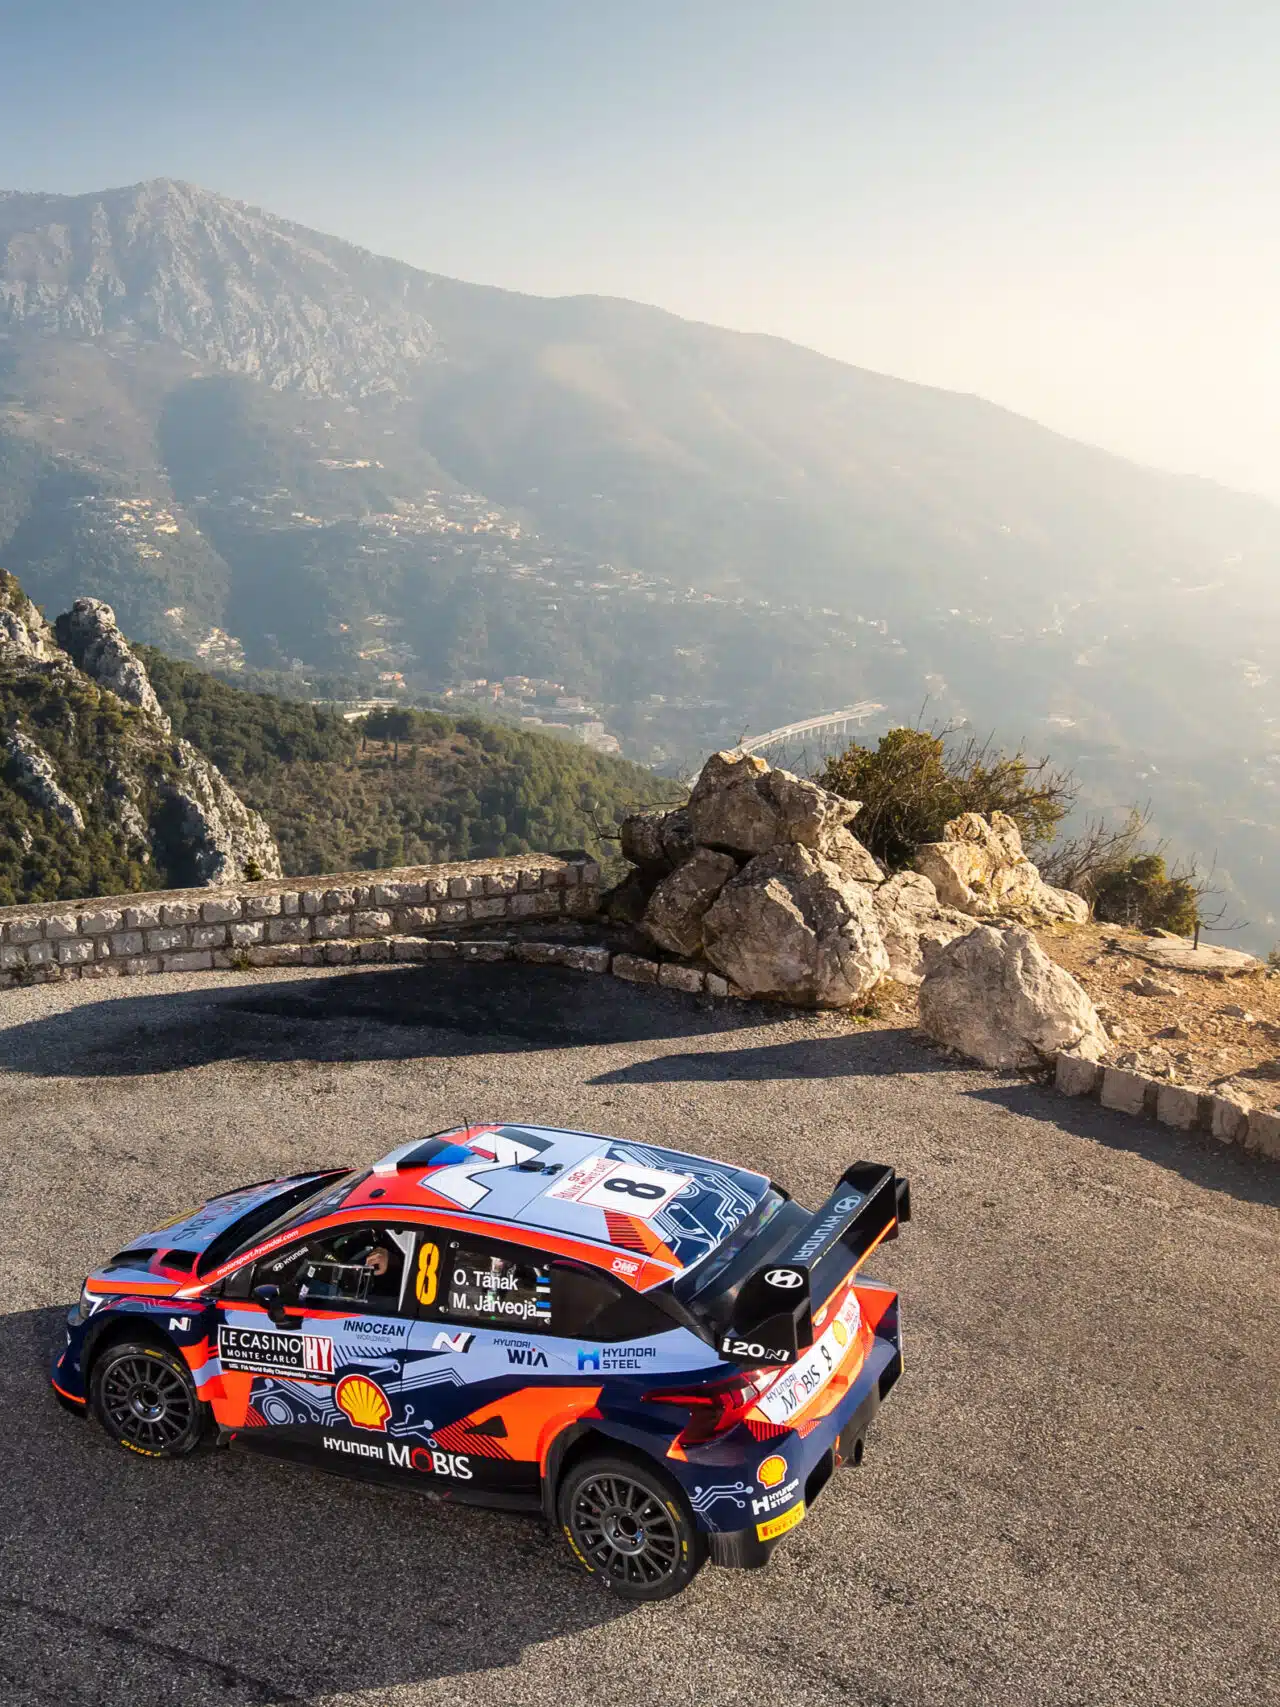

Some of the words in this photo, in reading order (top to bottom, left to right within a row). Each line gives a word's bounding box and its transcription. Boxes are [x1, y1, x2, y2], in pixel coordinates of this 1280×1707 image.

[604, 1178, 666, 1200] 8
[792, 1215, 844, 1261] HYUNDAI
[217, 1230, 299, 1276] motorsport.hyundai.com
[284, 1246, 309, 1265] HYUNDAI
[416, 1242, 440, 1305] 8
[611, 1260, 639, 1274] OMP
[454, 1269, 470, 1286] O.
[473, 1271, 518, 1290] Tänak
[453, 1293, 470, 1310] M.
[474, 1295, 537, 1320] Järveoja
[343, 1320, 406, 1337] INNOCEAN
[356, 1333, 392, 1344] WORLDWIDE
[222, 1331, 237, 1346] LE
[240, 1333, 301, 1353] CASINO
[493, 1338, 531, 1349] HYUNDAI
[603, 1347, 656, 1357] HYUNDAI
[722, 1338, 765, 1357] i20
[305, 1337, 330, 1370] HY
[507, 1348, 548, 1368] WIA
[603, 1359, 641, 1369] STEEL
[821, 1345, 833, 1372] 8
[249, 1365, 262, 1373] World
[263, 1367, 275, 1375] Rally
[766, 1372, 797, 1403] HYUNDAI
[780, 1364, 820, 1415] MOBIS
[323, 1437, 384, 1459] HYUNDAI
[387, 1442, 473, 1480] MOBIS
[769, 1478, 799, 1501] HYUNDAI
[771, 1492, 794, 1508] STEEL
